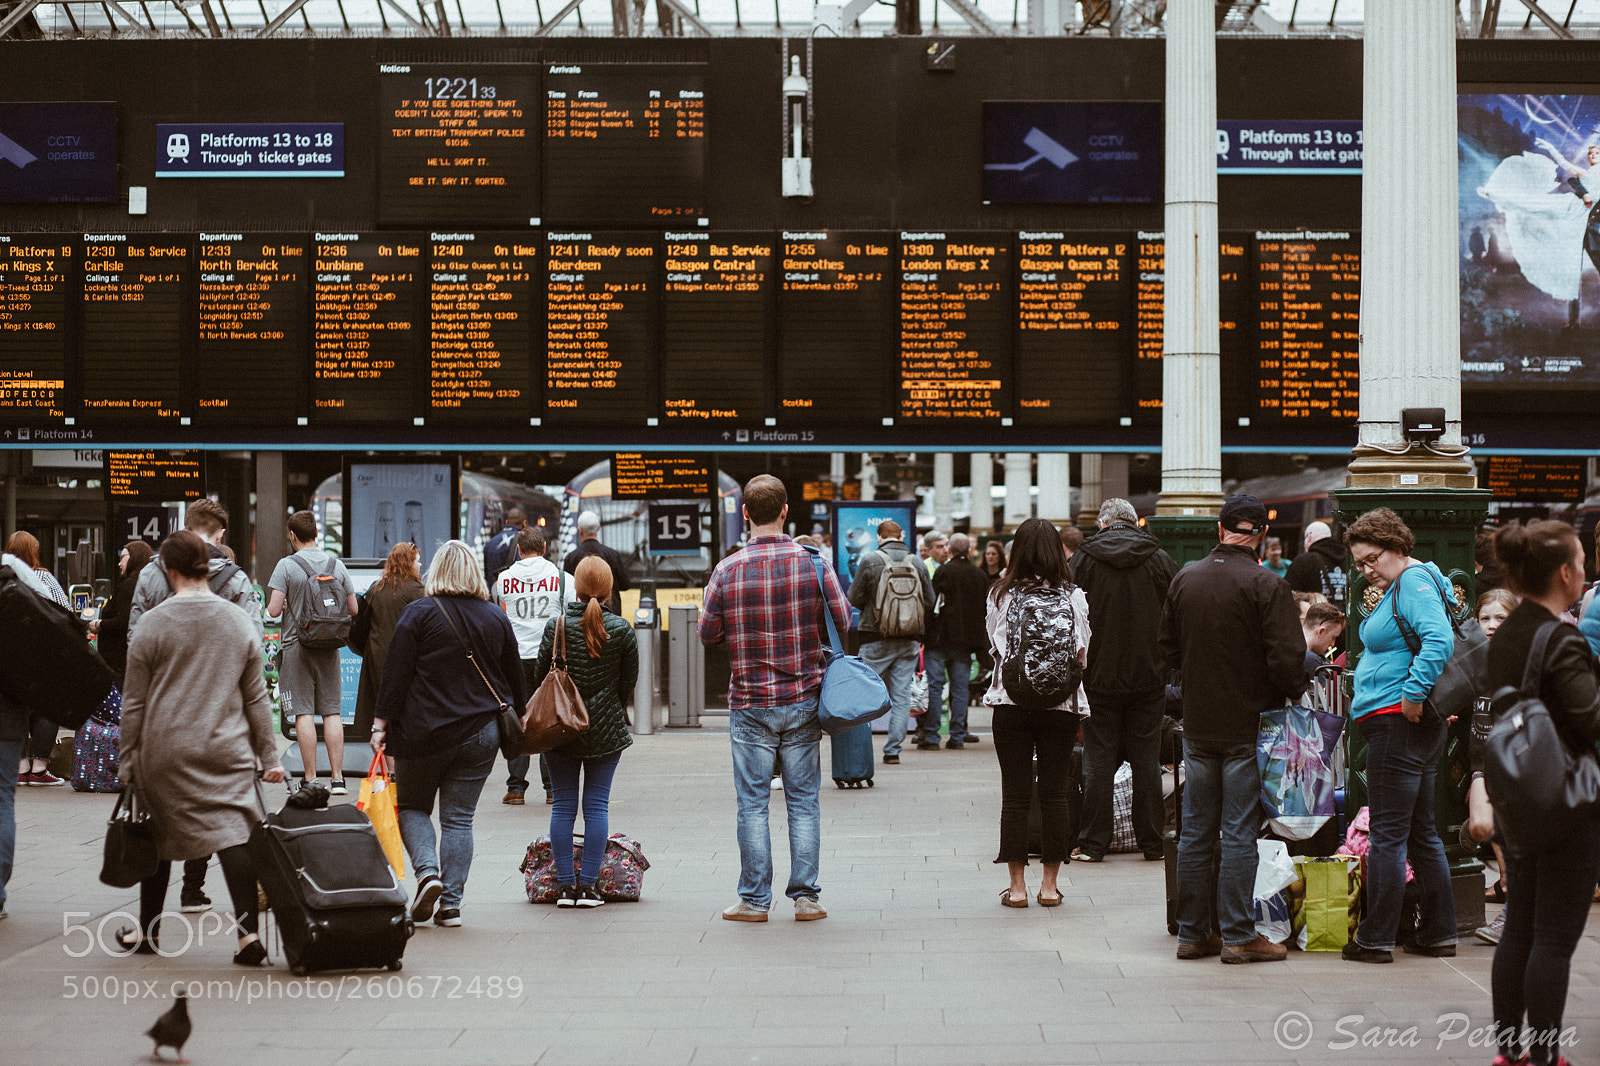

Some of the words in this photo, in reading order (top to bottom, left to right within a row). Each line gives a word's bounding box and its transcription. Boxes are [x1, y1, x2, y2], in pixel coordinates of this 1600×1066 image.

[380, 64, 410, 73] Notices
[549, 66, 581, 74] Arrivals
[424, 78, 477, 99] 12:21
[481, 87, 496, 99] 33
[395, 110, 428, 118] DOESN'T
[431, 110, 450, 118] LOOK
[454, 110, 480, 119] RIGHT,
[484, 110, 508, 118] SPEAK
[512, 110, 522, 118] TO
[47, 136, 81, 146] CCTV
[200, 134, 269, 147] Platforms
[273, 134, 290, 147] 13
[294, 134, 310, 147] to
[315, 134, 333, 147] 18
[1088, 136, 1124, 146] CCTV
[1240, 130, 1310, 144] Platforms
[1314, 130, 1332, 144] 13
[1336, 130, 1352, 144] to
[47, 150, 95, 161] operates
[200, 151, 251, 165] Through
[258, 151, 294, 163] ticket
[298, 152, 332, 165] gates
[1088, 150, 1139, 161] operates
[1240, 148, 1293, 163] Through
[1299, 148, 1336, 160] ticket
[428, 158, 450, 166] WE'LL
[454, 158, 474, 166] SORT
[478, 158, 489, 166] IT.
[84, 234, 126, 242] Departures
[200, 233, 242, 242] Departures
[315, 233, 358, 242] Departures
[431, 233, 475, 242] Departures
[548, 232, 592, 241] Departures
[665, 232, 709, 240] Departures
[783, 232, 827, 240] Departures
[901, 232, 946, 241] Departures
[1019, 231, 1064, 240] Departures
[1256, 231, 1304, 240] Subsequent
[1305, 231, 1350, 240] Departures
[10, 247, 55, 257] Platform
[62, 247, 71, 257] 19
[86, 247, 115, 256] 12:30
[128, 247, 144, 256] Bus
[150, 247, 186, 256] Service
[202, 245, 231, 256] 12:33
[262, 245, 275, 256] On
[281, 245, 302, 256] time
[317, 245, 347, 256] 12:36
[378, 245, 392, 256] On
[397, 245, 419, 256] time
[433, 245, 463, 256] 12:40
[494, 245, 508, 256] On
[513, 245, 536, 256] time
[550, 245, 579, 256] 12:41
[588, 245, 621, 258] Ready
[626, 247, 653, 256] soon
[667, 245, 698, 256] 12:49
[710, 245, 728, 256] Bus
[732, 245, 770, 256] Service
[785, 245, 815, 256] 12:55
[846, 245, 861, 256] On
[866, 245, 888, 256] time
[903, 244, 934, 256] 13:00
[947, 244, 995, 256] Platform
[1022, 244, 1052, 256] 13:02
[1060, 244, 1109, 256] Platform
[1115, 244, 1126, 256] 12
[14, 261, 41, 272] Kings
[46, 261, 54, 271] X
[84, 261, 124, 271] Carlisle
[200, 260, 231, 271] North
[237, 260, 278, 271] Berwick
[316, 260, 364, 271] Dunblane
[548, 260, 601, 271] Aberdeen
[666, 260, 709, 272] Glasgow
[713, 260, 755, 271] Central
[783, 259, 844, 270] Glenrothes
[901, 259, 942, 270] London
[946, 259, 976, 272] Kings
[980, 259, 989, 270] X
[1020, 259, 1064, 272] Glasgow
[1068, 259, 1102, 270] Queen
[1106, 259, 1120, 270] St
[133, 400, 162, 408] Express
[35, 430, 77, 438] Platform
[80, 430, 93, 438] 14
[754, 431, 798, 441] Platform
[801, 431, 814, 441] 15
[1472, 434, 1485, 444] 16
[127, 516, 160, 540] 14
[657, 515, 691, 539] 15
[516, 596, 550, 619] 012
